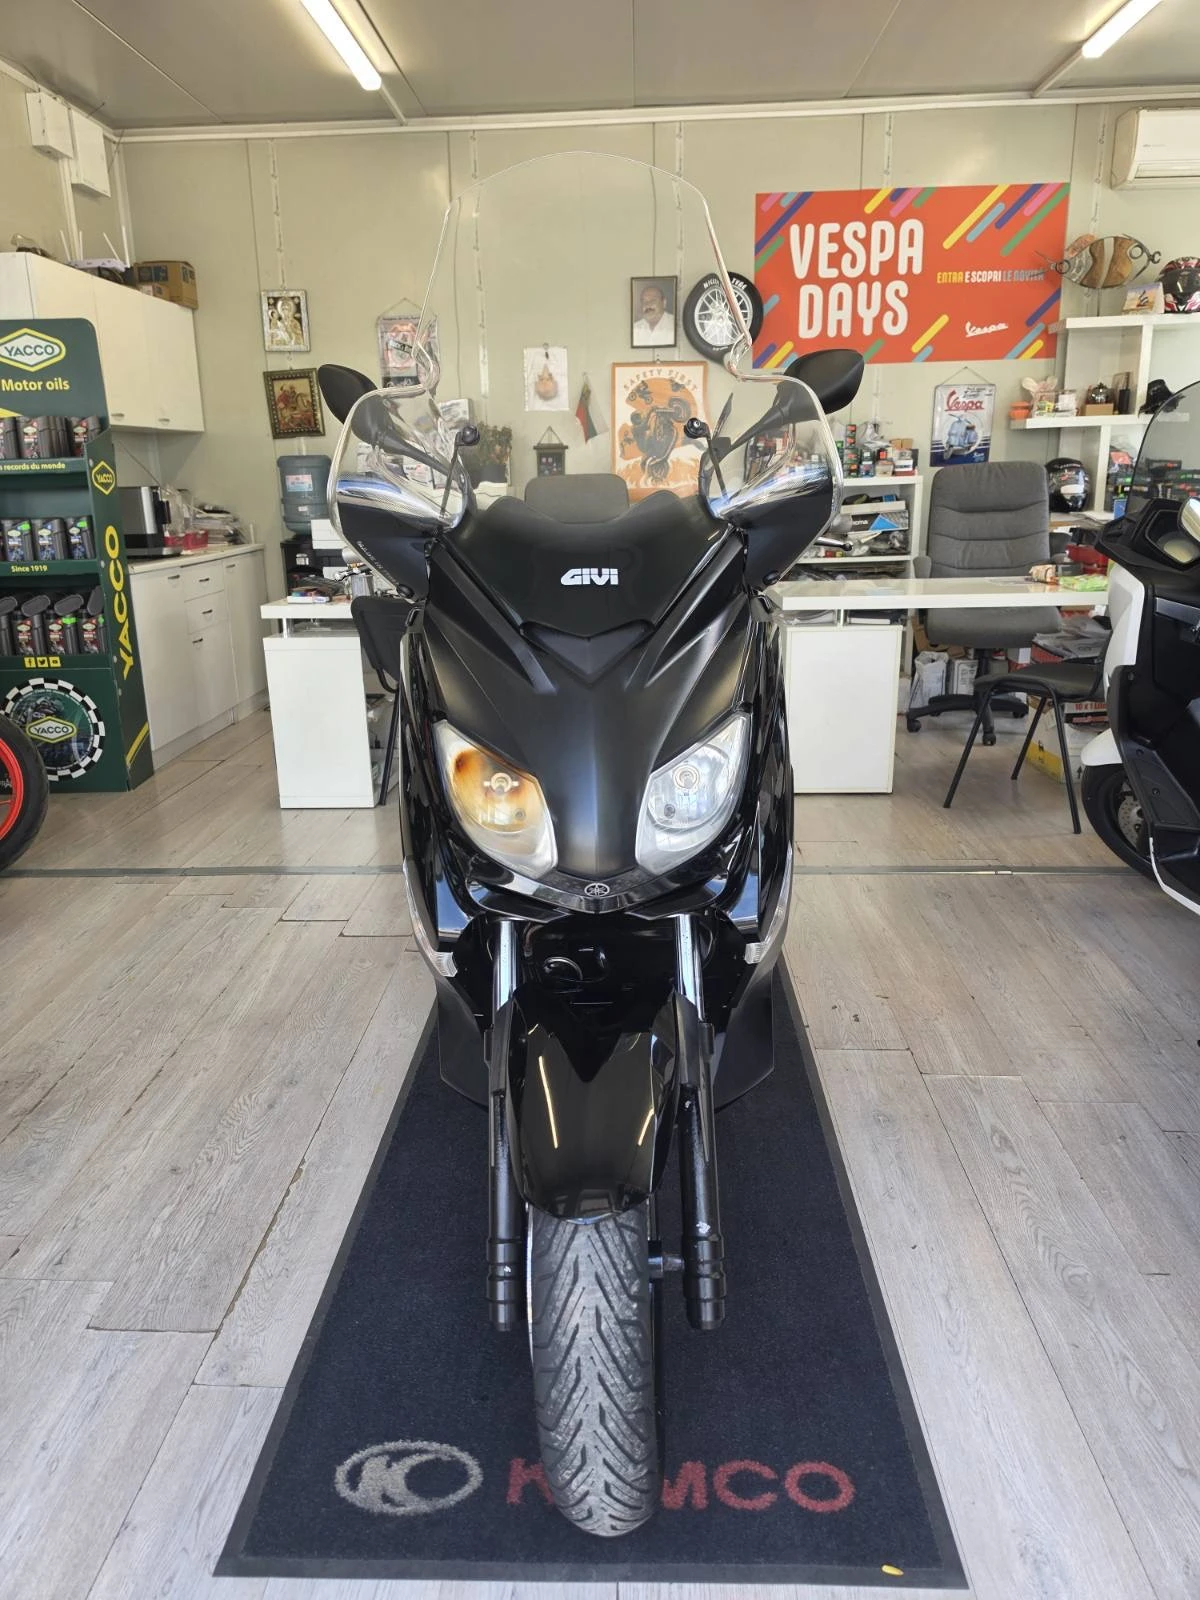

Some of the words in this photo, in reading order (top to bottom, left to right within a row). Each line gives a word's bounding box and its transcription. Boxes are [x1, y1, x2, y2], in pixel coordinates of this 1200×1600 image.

[790, 218, 924, 279] VESPA
[936, 271, 963, 284] ENTRA
[965, 271, 970, 283] E
[971, 270, 1001, 283] SCOPRI
[798, 280, 909, 339] DAYS
[965, 320, 1008, 338] Vespa
[4, 344, 55, 357] YACCO
[1, 378, 43, 391] Motor
[46, 377, 70, 391] oils
[623, 368, 662, 392] SAFETY
[668, 369, 698, 392] FIRST
[944, 389, 985, 412] Vespa
[4, 463, 30, 471] records
[30, 462, 40, 470] du
[41, 462, 65, 470] monde
[11, 565, 30, 573] Since
[31, 564, 48, 572] 1919
[560, 567, 619, 586] GIVI
[104, 524, 134, 681] YACCO
[34, 726, 69, 735] YACCO
[505, 1457, 856, 1513] KMCO
